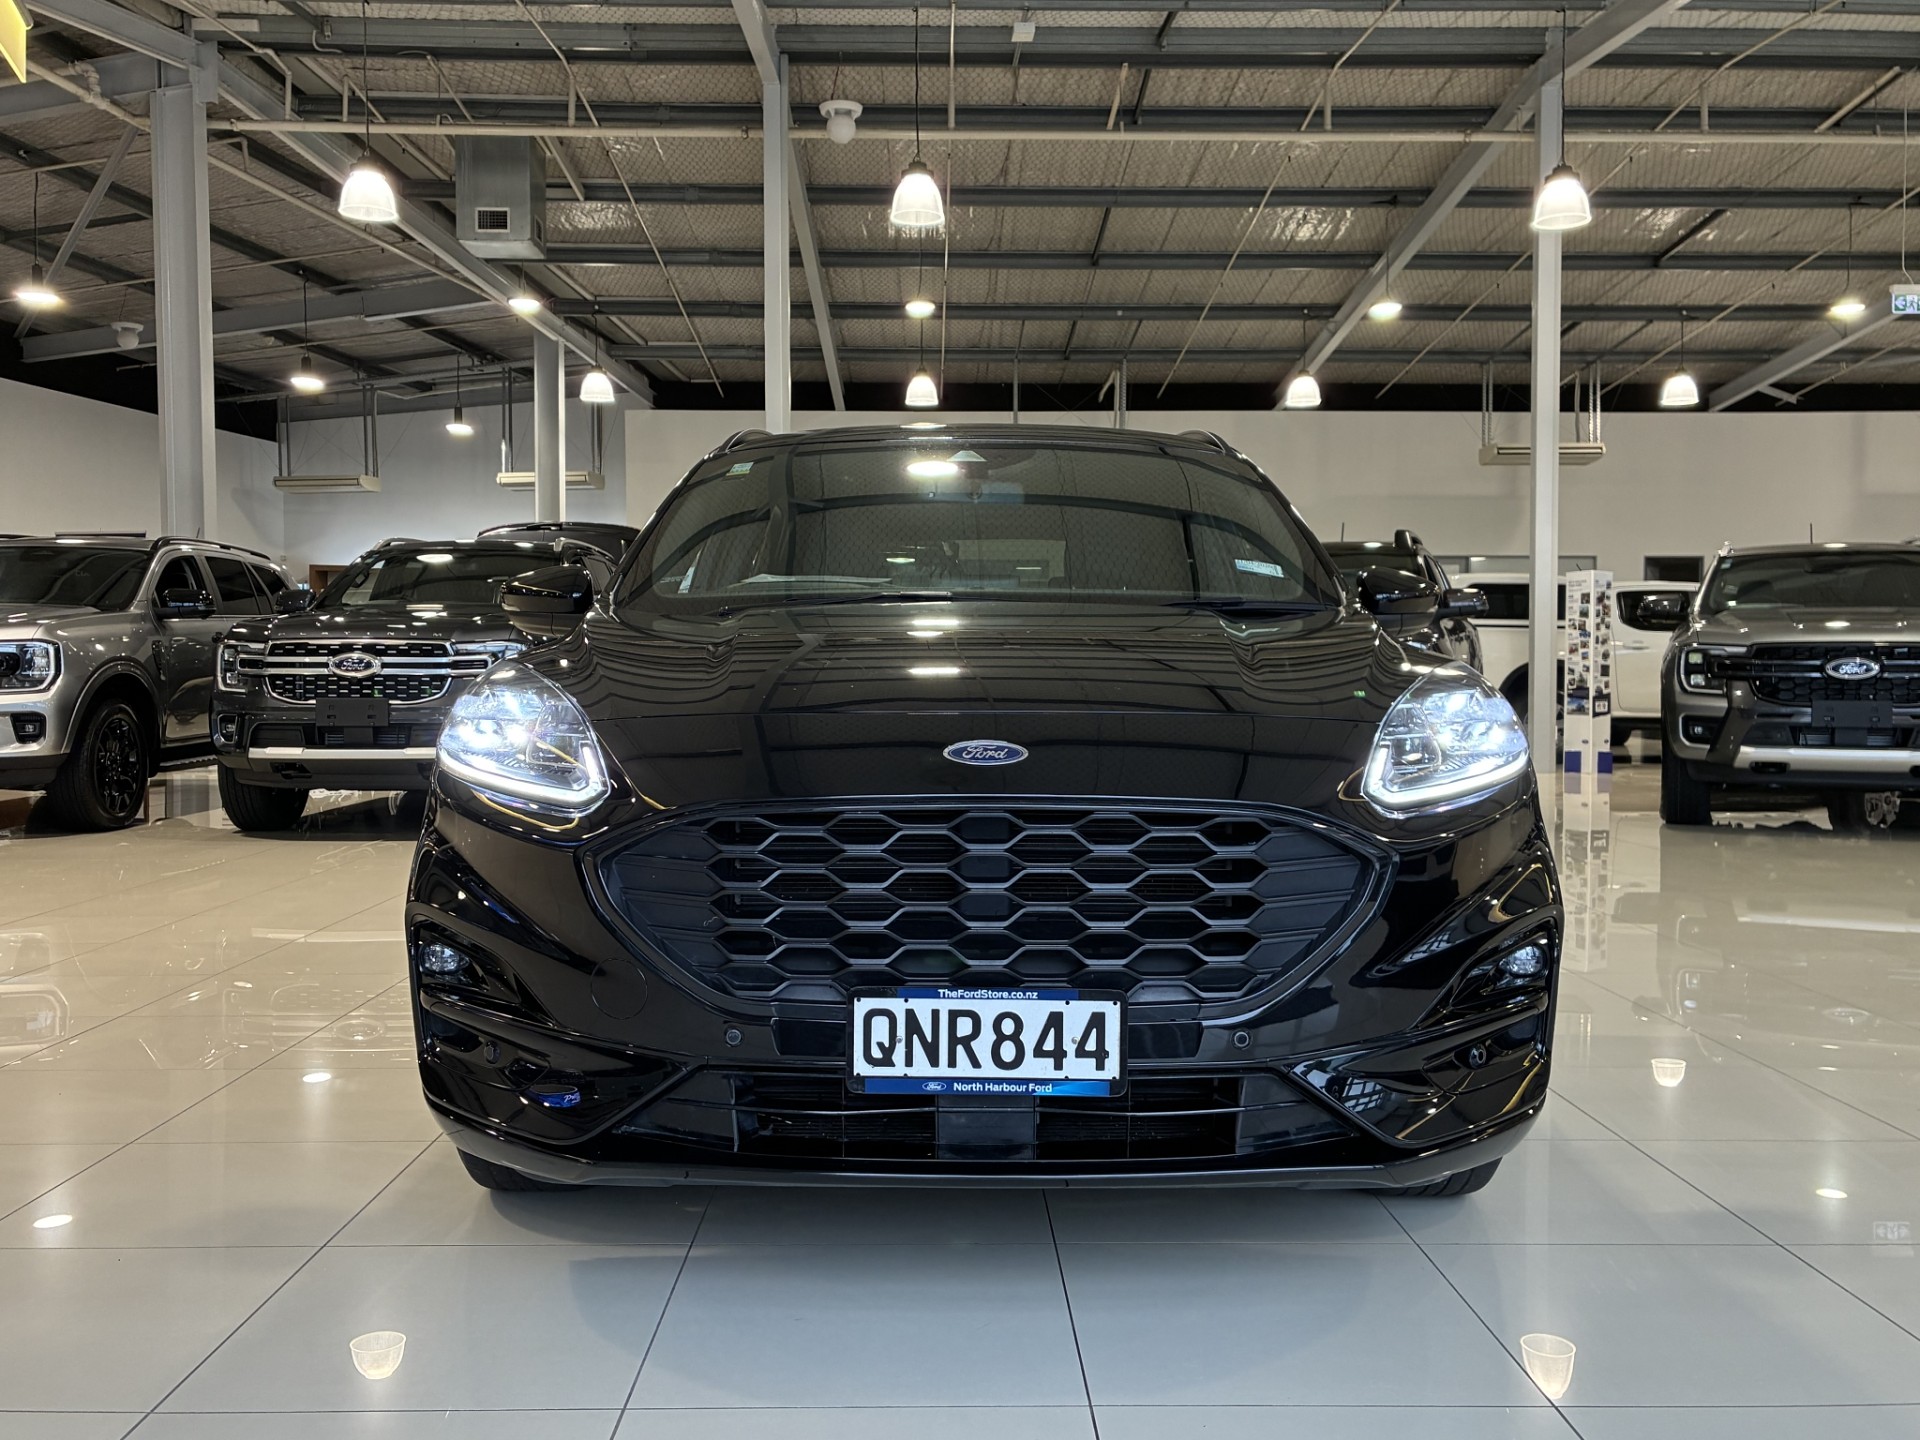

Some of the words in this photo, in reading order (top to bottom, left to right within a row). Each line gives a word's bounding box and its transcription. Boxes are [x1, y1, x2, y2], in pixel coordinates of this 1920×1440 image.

[1839, 662, 1867, 675] Ford
[962, 745, 1009, 759] Ford
[937, 988, 1038, 999] TheFordStore.co.nz
[862, 1008, 1110, 1071] QNR844
[953, 1082, 983, 1092] North
[984, 1083, 1027, 1093] Harbour
[1028, 1083, 1053, 1093] Ford
